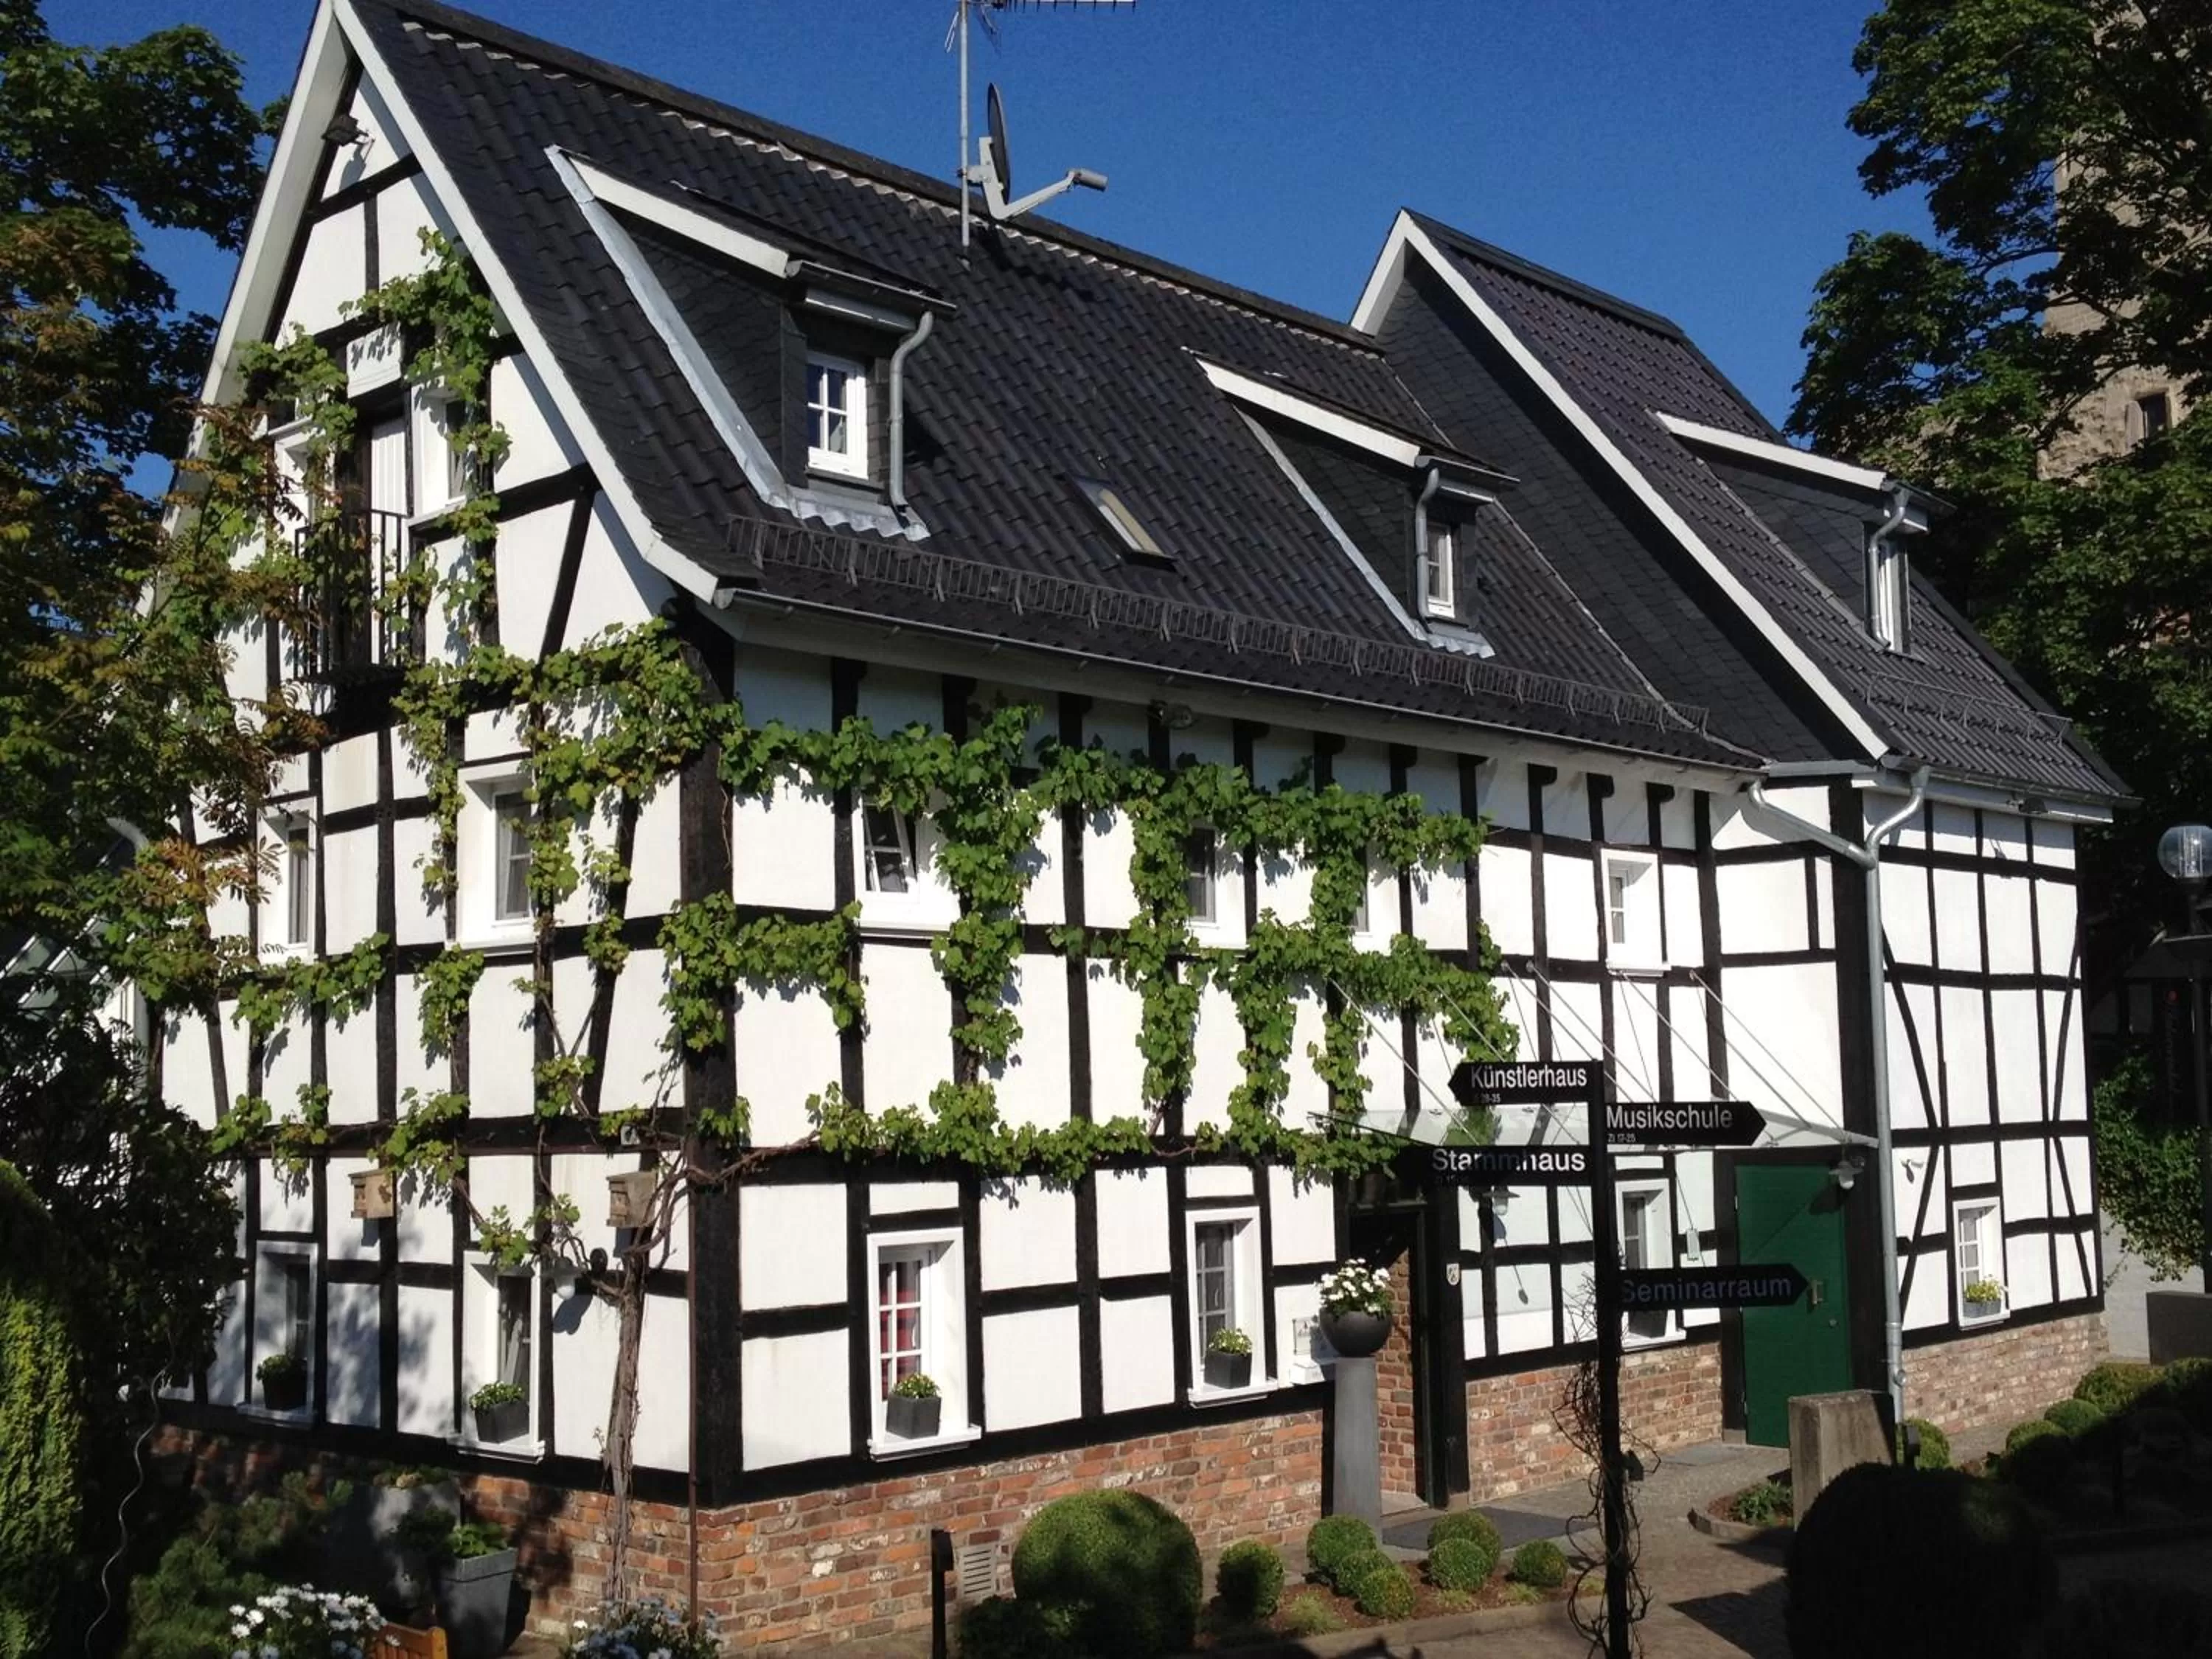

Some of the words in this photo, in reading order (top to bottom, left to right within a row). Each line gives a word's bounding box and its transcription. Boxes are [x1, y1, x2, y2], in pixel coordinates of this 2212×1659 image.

[1471, 1062, 1587, 1089] Künstlerhaus
[1606, 1104, 1733, 1130] Musikschule
[1432, 1147, 1586, 1172] Stammhaus
[1621, 1277, 1793, 1303] Seminarraum
